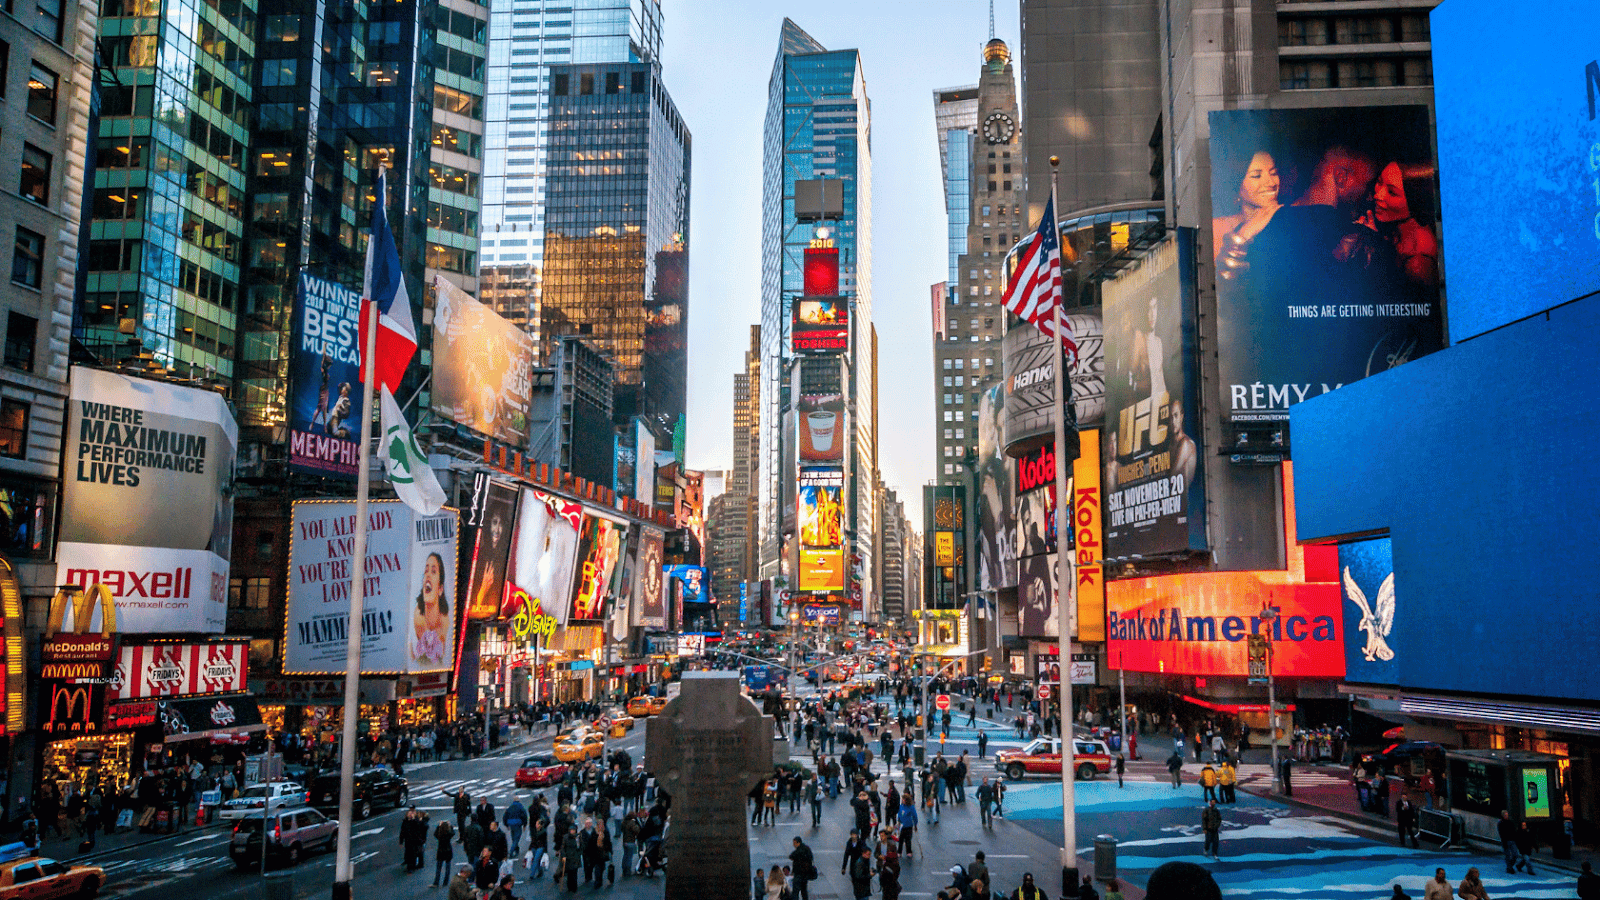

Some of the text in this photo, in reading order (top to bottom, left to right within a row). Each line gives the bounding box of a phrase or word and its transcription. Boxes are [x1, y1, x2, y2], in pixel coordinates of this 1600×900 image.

[810, 240, 833, 248] 2010
[306, 293, 324, 311] 2010
[1288, 305, 1318, 318] THINGS
[1320, 305, 1337, 318] ARE
[1339, 304, 1374, 318] GETTING
[794, 338, 846, 348] TOSHIBA
[1230, 382, 1311, 410] RÉMY
[82, 400, 144, 426] WHERE
[1118, 390, 1170, 456] UFC
[80, 418, 206, 458] MAXIMUM
[78, 442, 204, 474] PERFORMANCE
[1149, 451, 1170, 476] PENN
[76, 460, 140, 487] LIVES
[1109, 491, 1124, 512] SAT.
[1124, 478, 1170, 508] NOVEMBER
[1170, 474, 1184, 496] 20
[1112, 508, 1124, 526] LIVE
[1135, 494, 1180, 522] PAY-PER-VIEW
[300, 510, 394, 540] YOU ALRADY
[1077, 487, 1100, 586] Kodak
[327, 534, 370, 559] KNO
[299, 552, 401, 584] YOU'RE ONNA
[66, 567, 192, 598] maxell
[322, 578, 352, 603] LOV
[298, 616, 350, 646] MAMM
[1110, 606, 1336, 642] Bank of America
[43, 642, 110, 652] McDonald's
[152, 669, 180, 680] FRIDAYS
[208, 666, 232, 676] FRIDAYS
